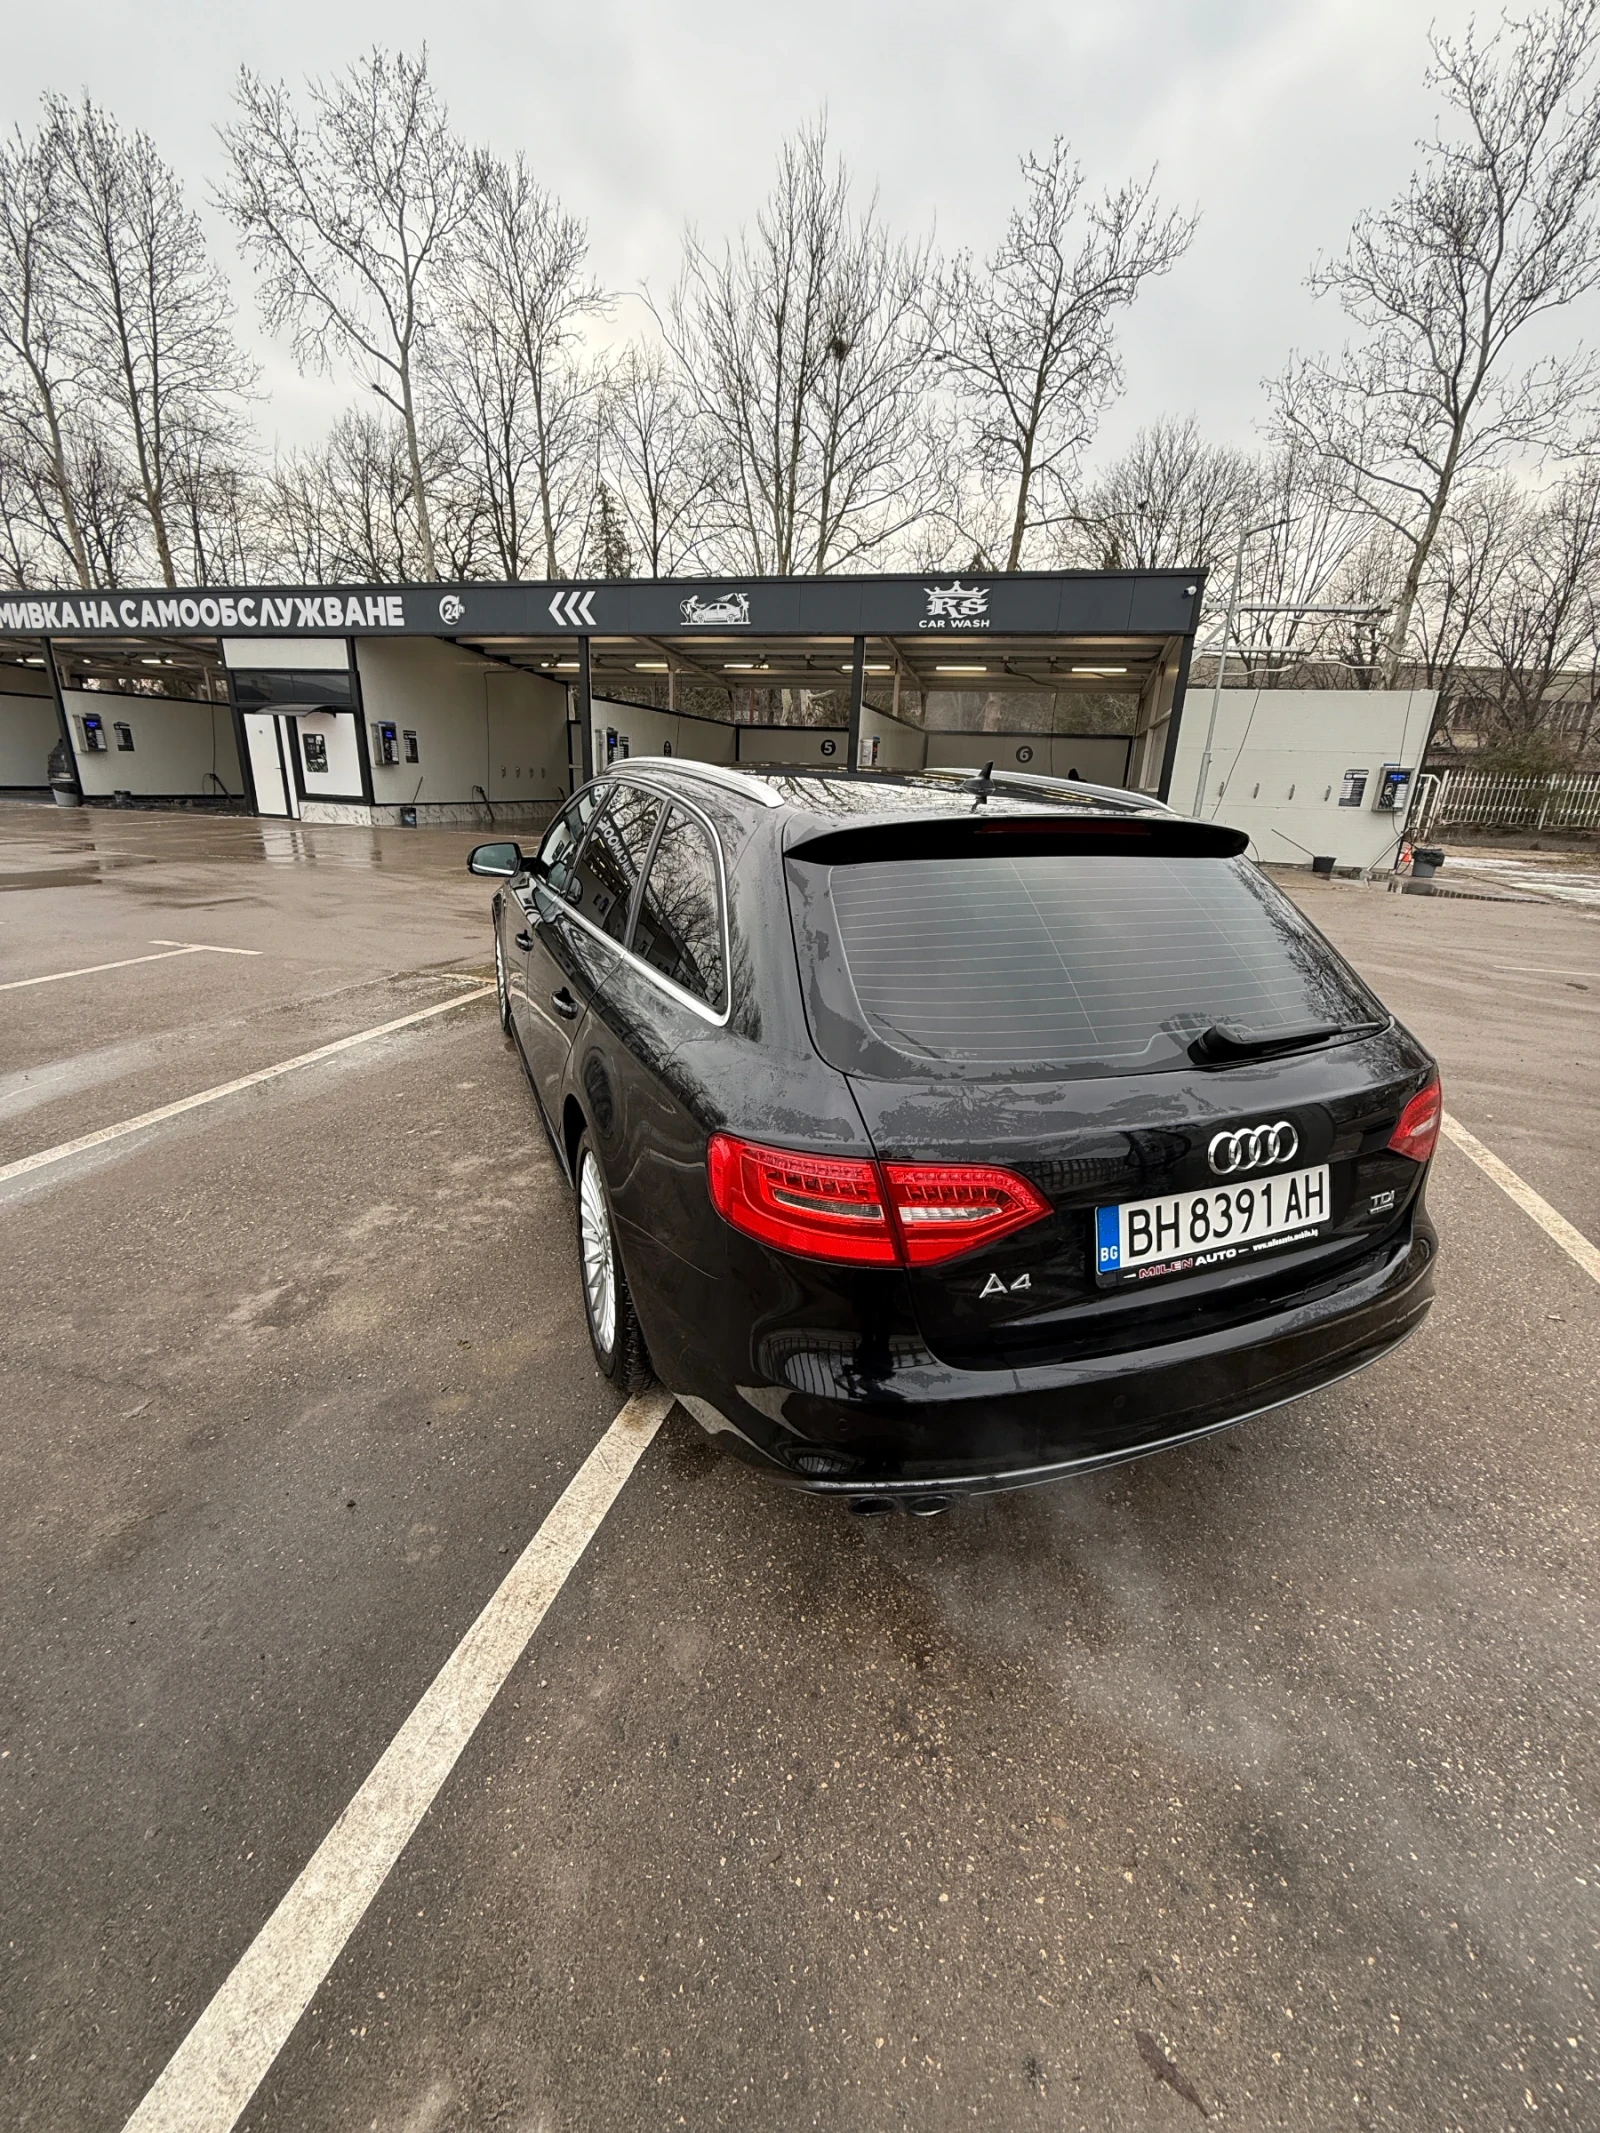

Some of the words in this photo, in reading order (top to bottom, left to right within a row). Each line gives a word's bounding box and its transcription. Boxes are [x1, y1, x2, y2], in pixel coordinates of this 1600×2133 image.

[79, 600, 119, 628] НА
[119, 596, 404, 628] САМООБСЛУЖВАНЕ
[445, 603, 465, 620] 24h
[918, 619, 945, 628] CAR
[950, 619, 990, 628] WASH
[823, 742, 833, 754] 5
[1019, 748, 1030, 761] 6
[1370, 1190, 1395, 1207] TDI
[1128, 1202, 1180, 1258] BH
[1190, 1183, 1272, 1244] 8391
[1284, 1171, 1324, 1223] AH
[1100, 1246, 1118, 1262] BG
[1138, 1258, 1193, 1279] MILEN
[1195, 1248, 1237, 1266] AUTO
[979, 1273, 1032, 1299] A4
